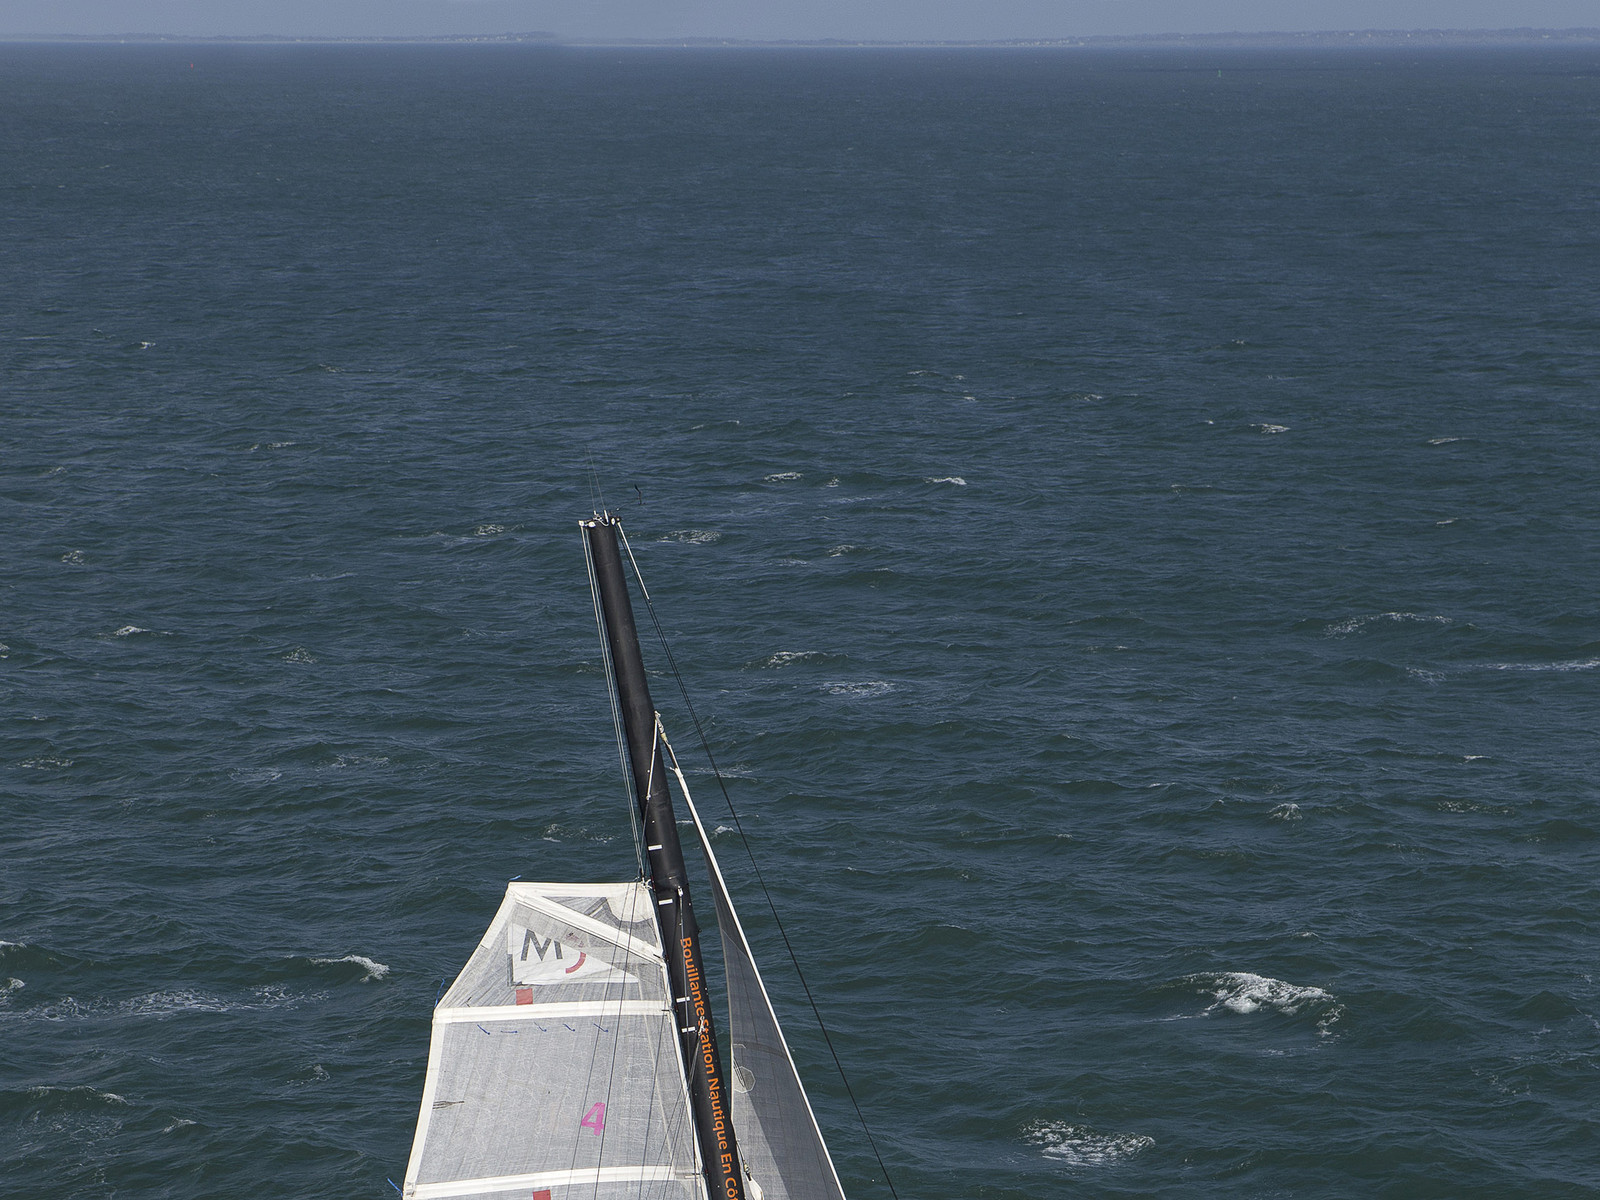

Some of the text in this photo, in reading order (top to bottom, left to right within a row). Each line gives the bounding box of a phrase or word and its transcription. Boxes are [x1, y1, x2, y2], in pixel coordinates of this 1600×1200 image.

[581, 1102, 605, 1136] 4
[680, 937, 705, 1017] Bouillante
[697, 1018, 715, 1074] Station
[708, 1077, 728, 1149] Nautique
[720, 1153, 733, 1174] En
